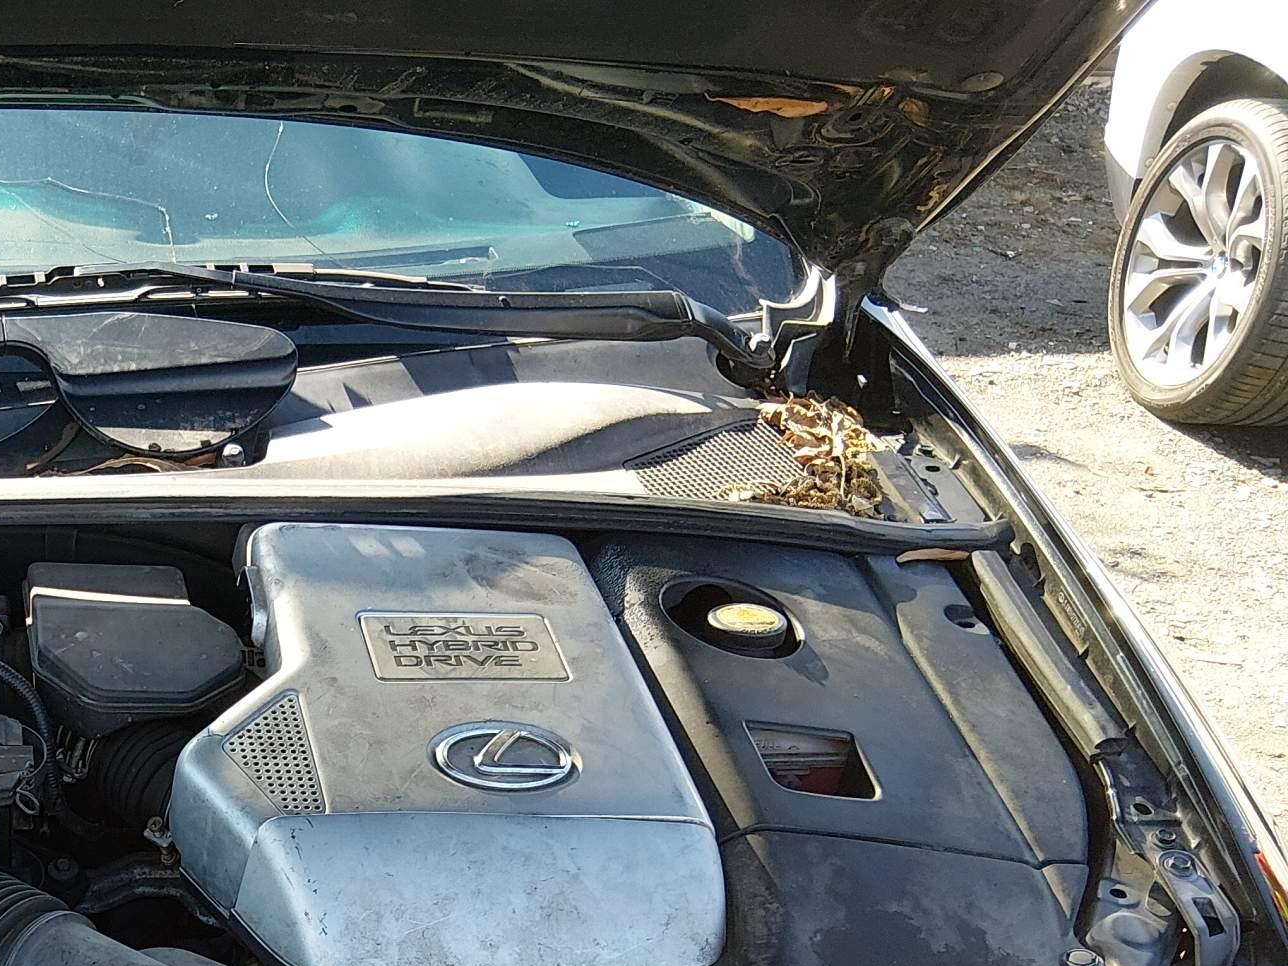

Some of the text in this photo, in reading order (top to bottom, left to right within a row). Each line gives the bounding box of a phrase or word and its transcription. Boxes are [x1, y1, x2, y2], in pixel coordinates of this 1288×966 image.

[383, 624, 526, 637] LEXUS
[389, 639, 539, 652] HYBRID
[393, 654, 523, 668] DRIVE
